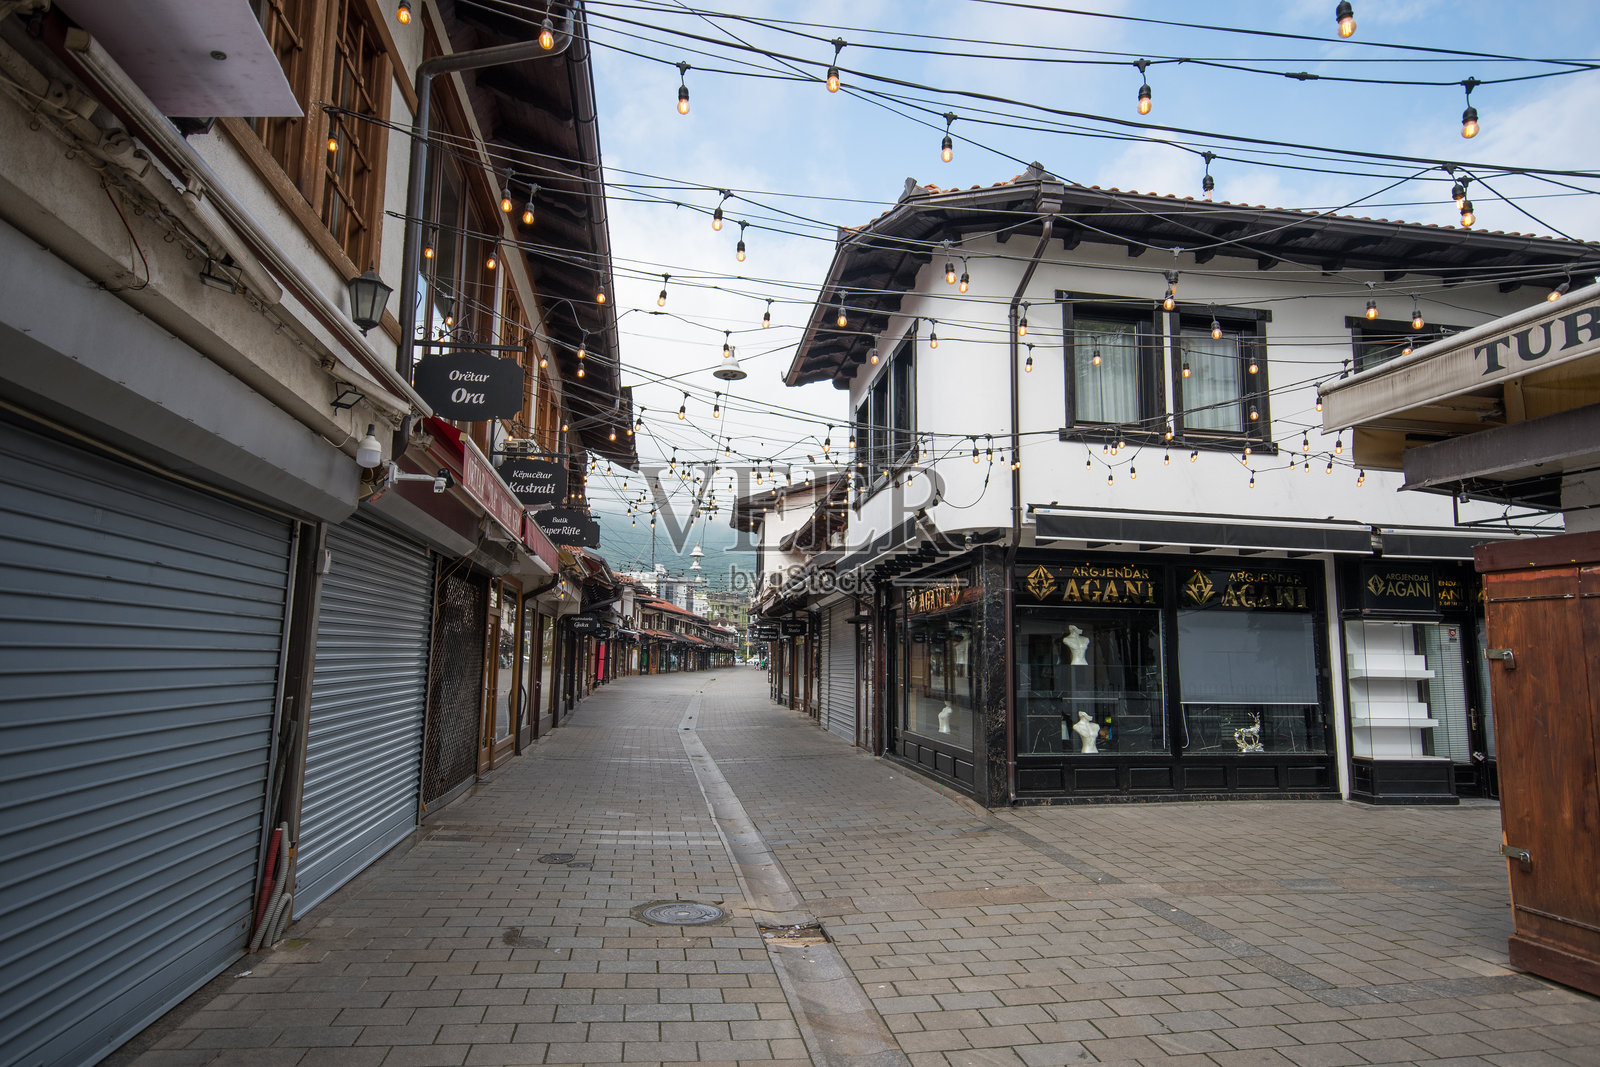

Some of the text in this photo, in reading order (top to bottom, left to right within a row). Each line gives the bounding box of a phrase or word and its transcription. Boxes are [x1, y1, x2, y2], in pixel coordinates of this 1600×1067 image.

[448, 369, 490, 382] Orëtar
[451, 387, 486, 404] Ora
[512, 469, 553, 480] Këpucëtar
[509, 481, 556, 494] Kastrati
[1072, 566, 1150, 579] ARGJENDAR
[1386, 573, 1429, 582] ARGJENDAR
[1063, 578, 1156, 604] AGANI
[1221, 584, 1309, 608] AGANI
[1386, 581, 1431, 598] AGANI
